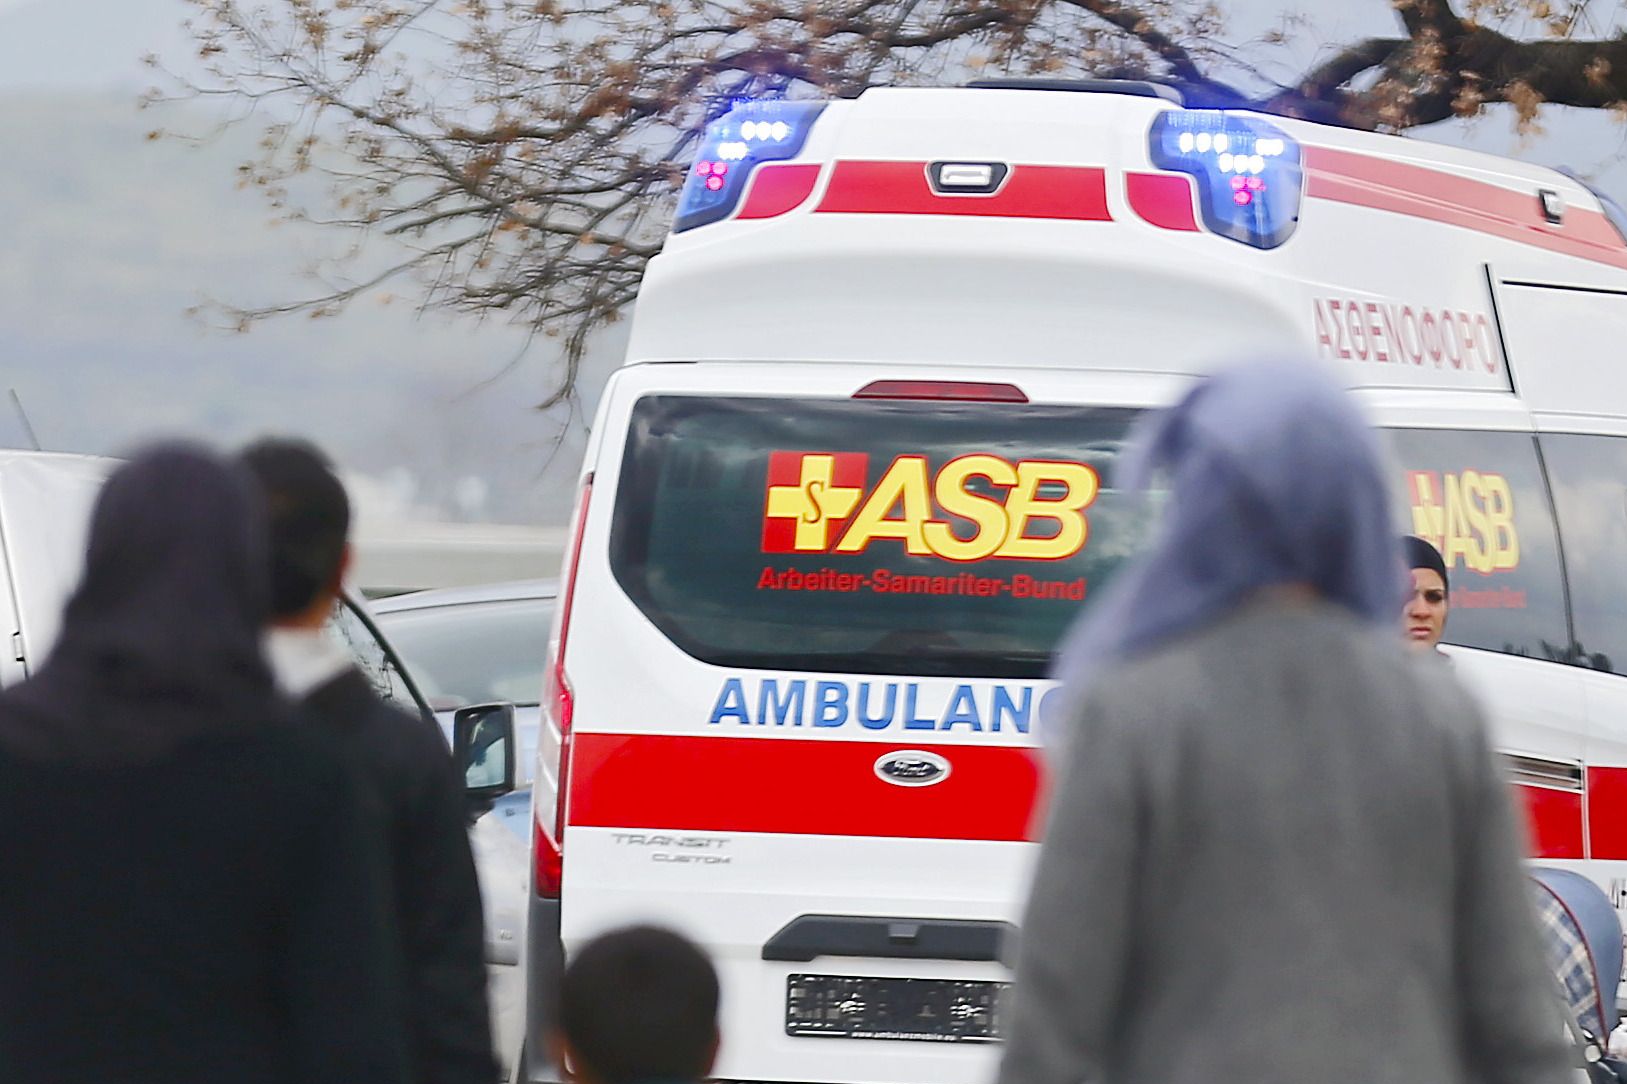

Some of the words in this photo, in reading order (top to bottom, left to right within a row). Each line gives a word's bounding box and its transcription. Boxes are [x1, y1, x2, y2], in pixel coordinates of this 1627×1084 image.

[1313, 299, 1500, 375] ΑΣΘΕΝΟΦΟΡΟ
[832, 452, 1099, 563] ASB
[756, 565, 1088, 601] Arbeiter-Samariter-Bund
